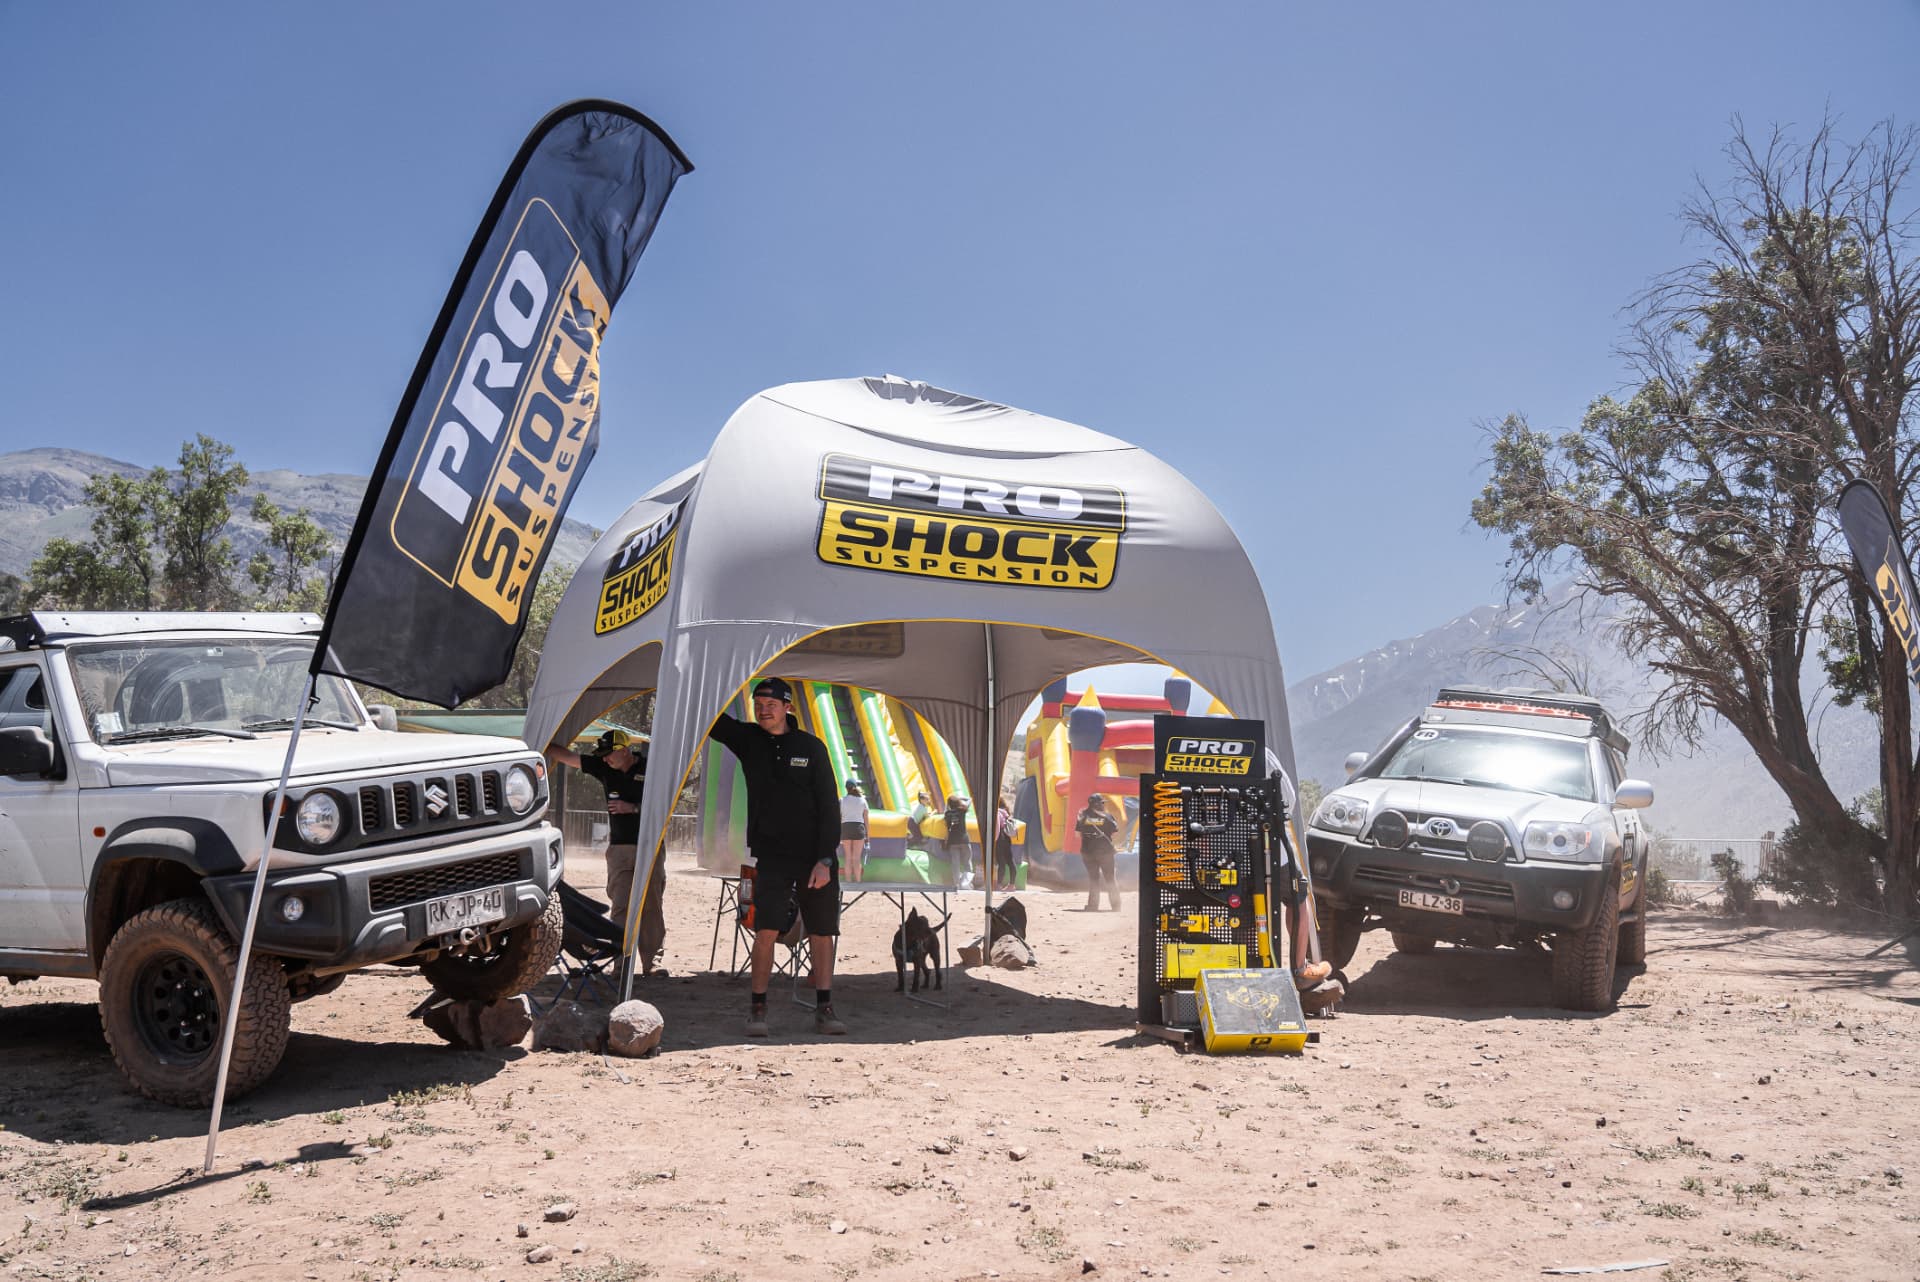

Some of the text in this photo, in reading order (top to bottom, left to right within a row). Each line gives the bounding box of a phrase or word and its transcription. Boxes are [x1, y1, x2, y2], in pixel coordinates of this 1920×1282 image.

[418, 250, 548, 525] PRO
[471, 280, 596, 597] SHOCK
[868, 465, 1083, 520] PRO
[836, 510, 1102, 568] SHOCK
[836, 546, 1098, 585] SUSPENSION
[602, 538, 673, 615] SHOCK
[601, 580, 668, 629] SUSPENSION
[1169, 756, 1245, 769] SHOCK
[1179, 740, 1243, 755] PRO
